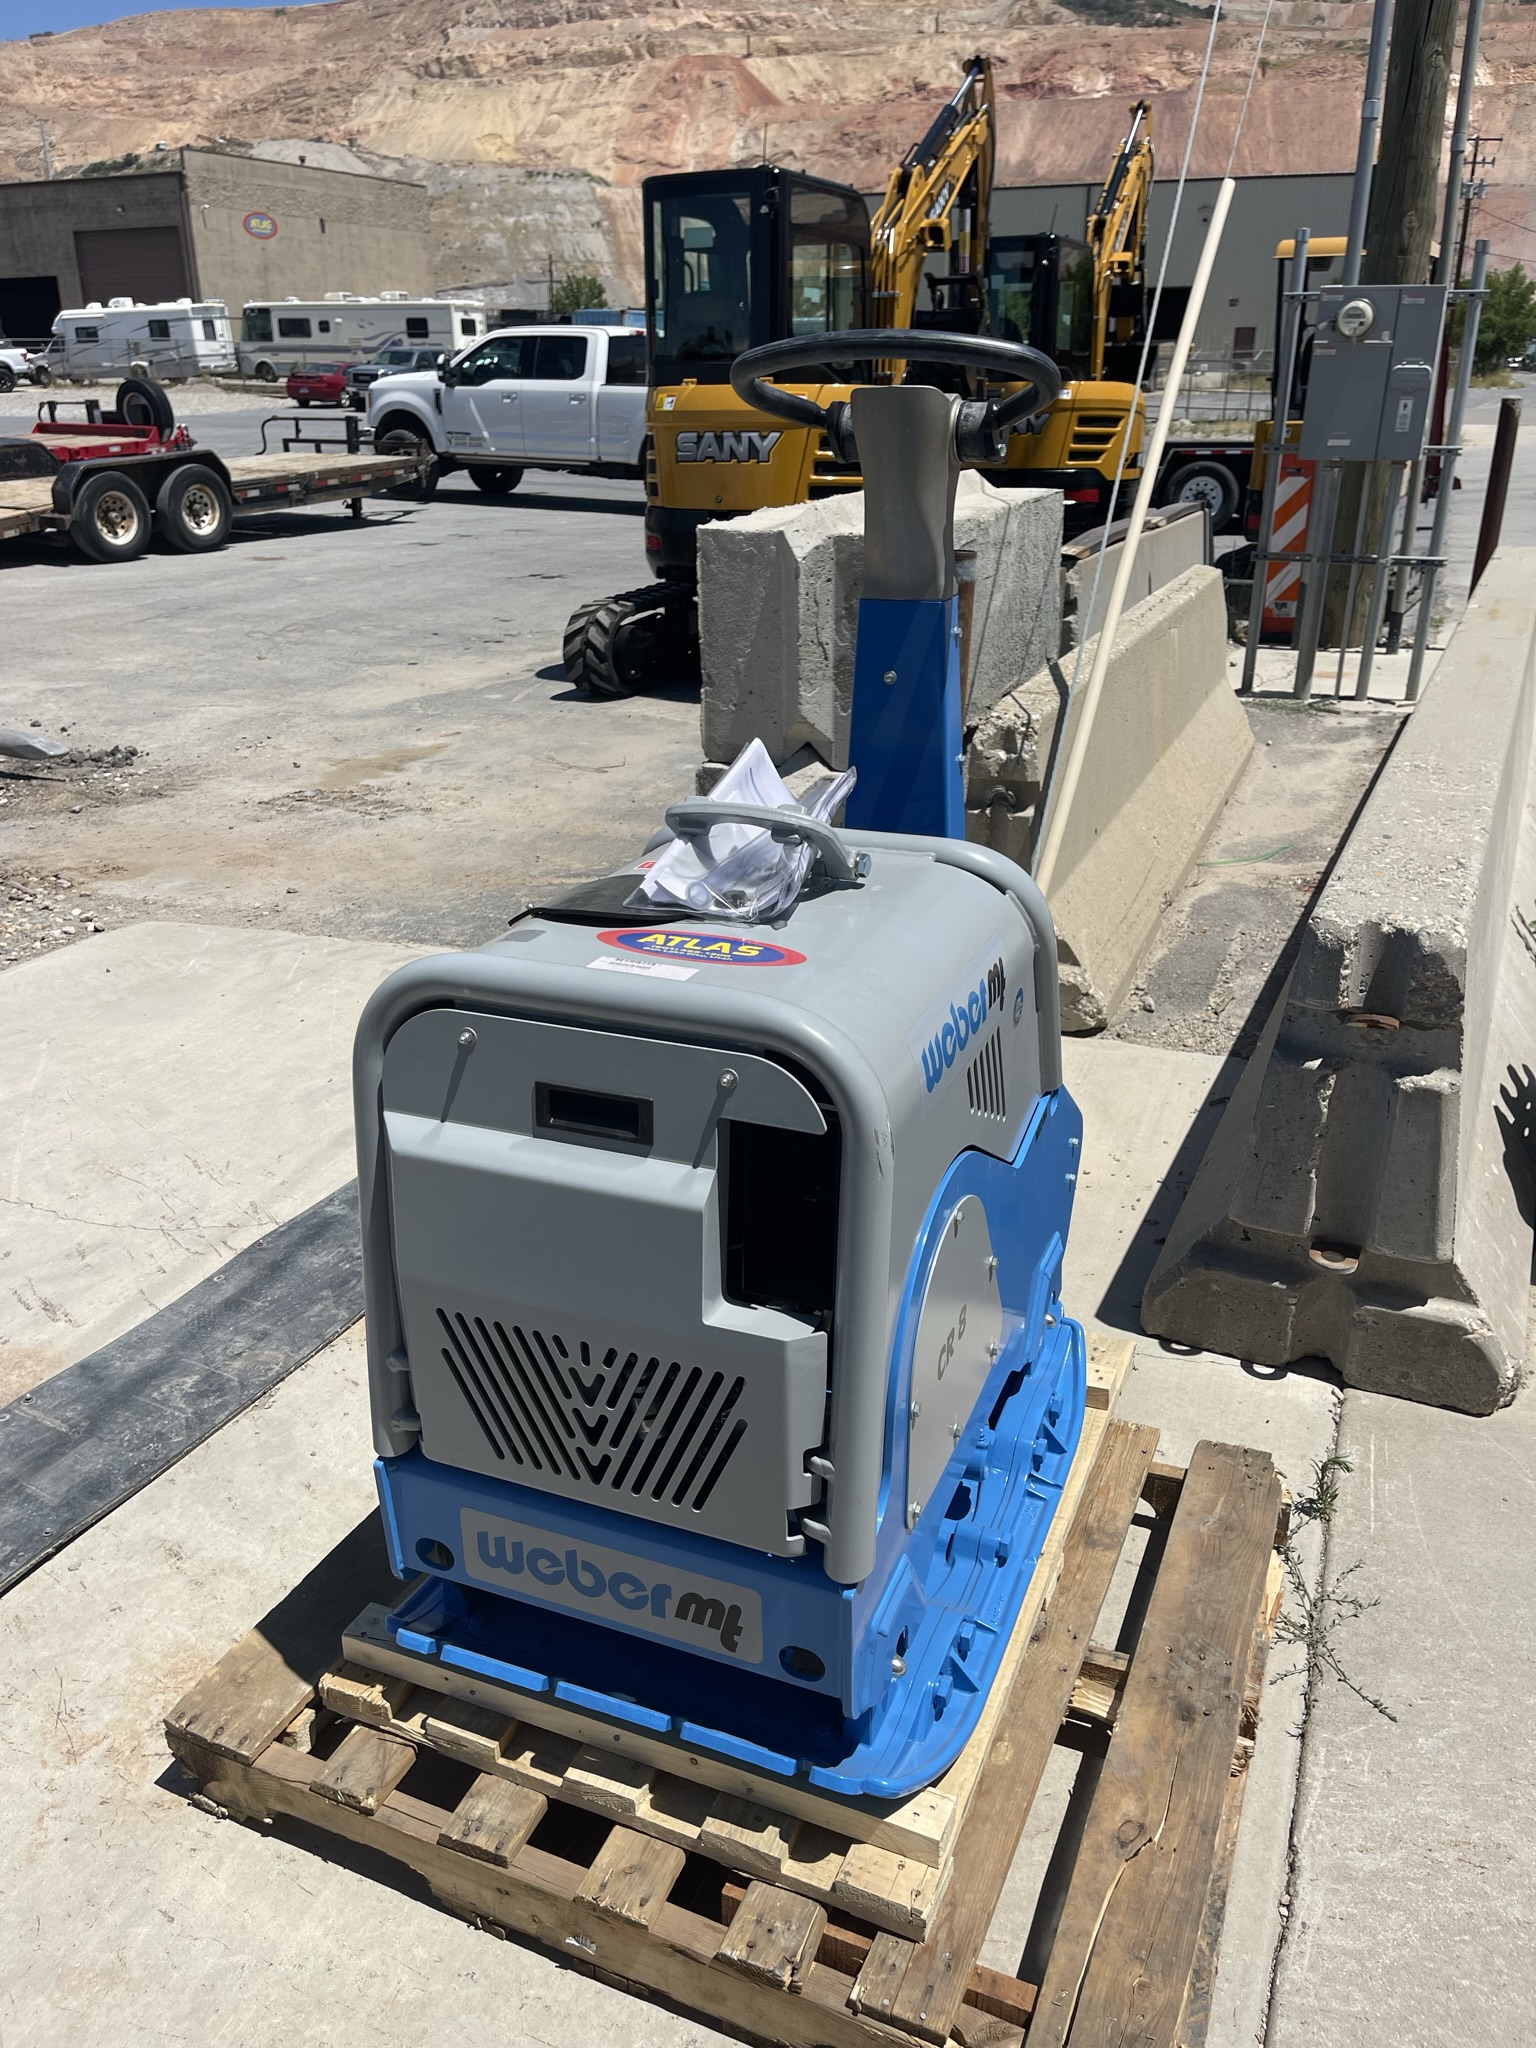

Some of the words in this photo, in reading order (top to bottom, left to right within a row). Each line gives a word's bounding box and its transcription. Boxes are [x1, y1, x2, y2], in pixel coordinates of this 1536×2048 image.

[676, 430, 784, 464] SANY
[636, 933, 765, 957] ATLAS
[921, 978, 987, 1093] weber
[937, 1327, 955, 1381] CR
[957, 1303, 967, 1341] 8
[476, 1530, 672, 1619] weber
[674, 1592, 744, 1654] mt
